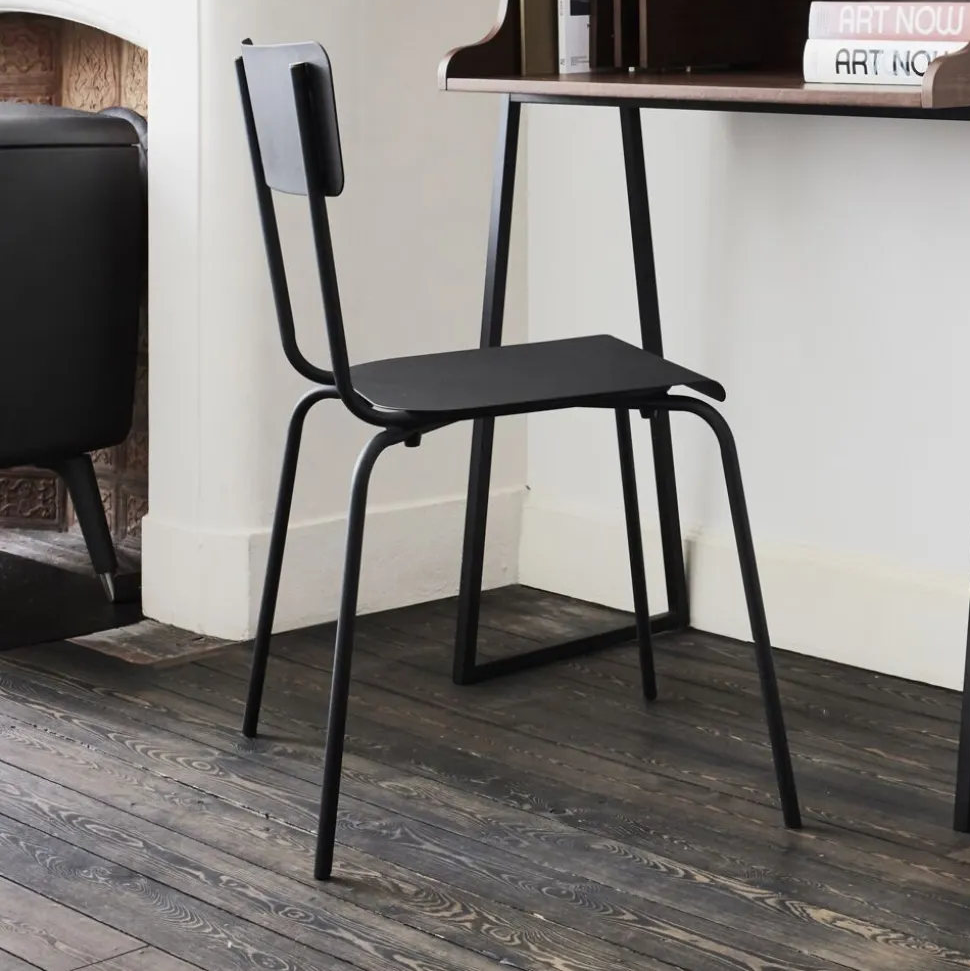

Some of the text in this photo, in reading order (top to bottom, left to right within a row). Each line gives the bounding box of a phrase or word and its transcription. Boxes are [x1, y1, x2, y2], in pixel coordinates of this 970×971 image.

[839, 5, 890, 35] ART
[895, 6, 966, 36] NOW
[835, 48, 884, 76] ART
